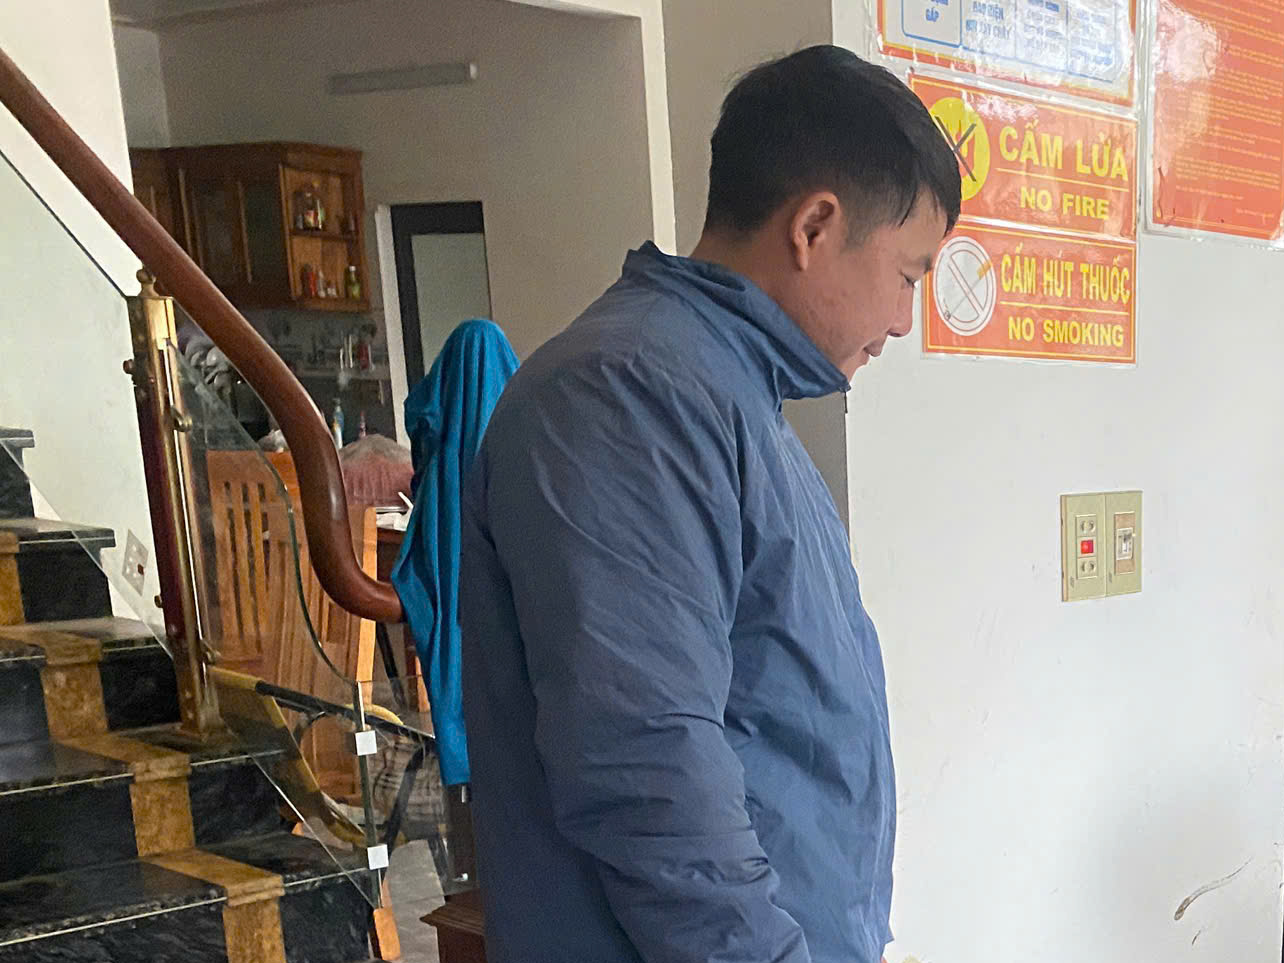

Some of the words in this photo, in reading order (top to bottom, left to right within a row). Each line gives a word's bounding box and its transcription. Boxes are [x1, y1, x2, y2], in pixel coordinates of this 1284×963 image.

[999, 119, 1063, 170] CẤM
[1020, 186, 1052, 212] NO
[1062, 192, 1109, 221] FIRE
[1001, 242, 1036, 295] CẤM
[1043, 249, 1074, 298] HÚT
[1080, 254, 1130, 304] THUỐC
[1008, 316, 1035, 341] NO
[1043, 319, 1124, 347] SMOKING
